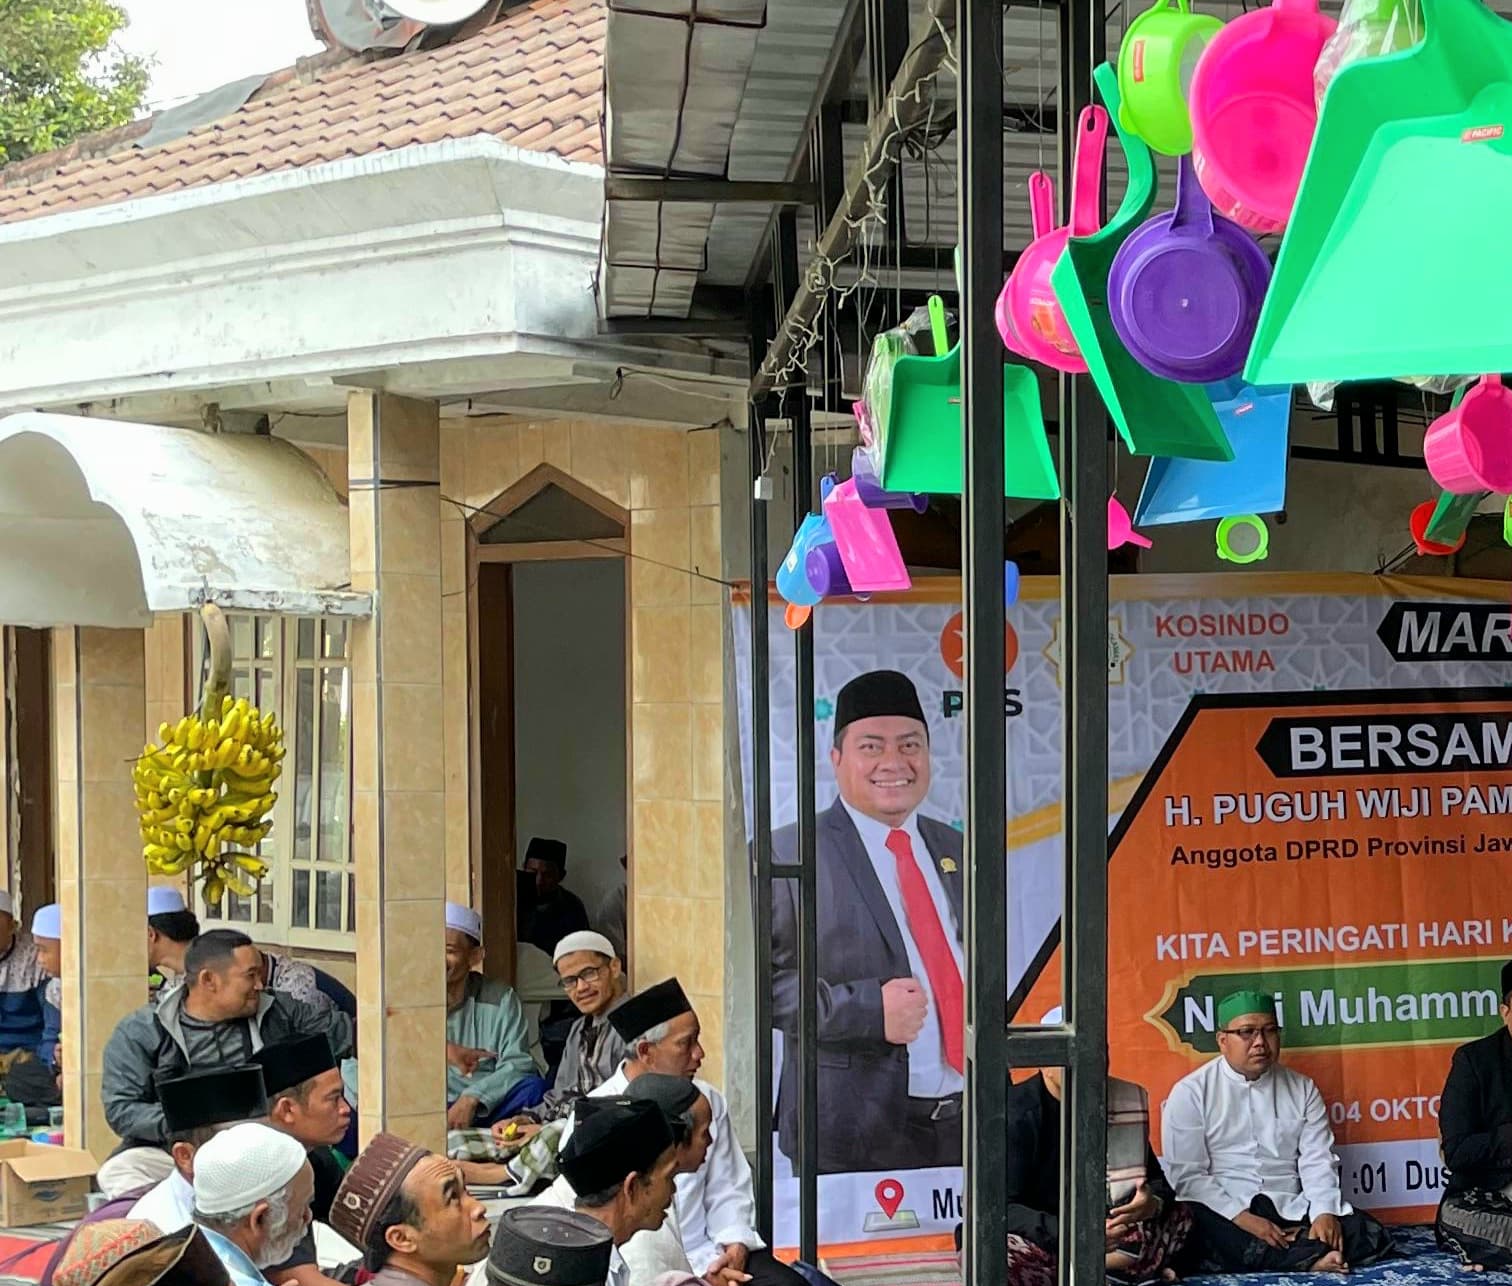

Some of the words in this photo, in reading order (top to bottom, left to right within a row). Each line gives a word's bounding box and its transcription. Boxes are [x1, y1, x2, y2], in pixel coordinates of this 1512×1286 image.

[1155, 613, 1290, 637] KOSINDO
[1173, 649, 1276, 673] UTAMA
[943, 689, 1023, 718] PS
[1165, 796, 1202, 826] H.
[1213, 790, 1347, 825] PUGUH
[1358, 787, 1432, 819] WIJI
[1170, 843, 1277, 869] Anggota
[1286, 838, 1359, 861] DPRD
[1368, 834, 1466, 858] Provinsi
[1156, 933, 1230, 960] KITA
[1238, 924, 1409, 956] PERINGATI
[1419, 920, 1493, 947] HARI
[1184, 992, 1284, 1033] Ni
[1300, 985, 1498, 1027] Muhamm
[1331, 1101, 1362, 1124] 04
[1370, 1095, 1441, 1122] OKTO
[1406, 1160, 1452, 1190] Dus
